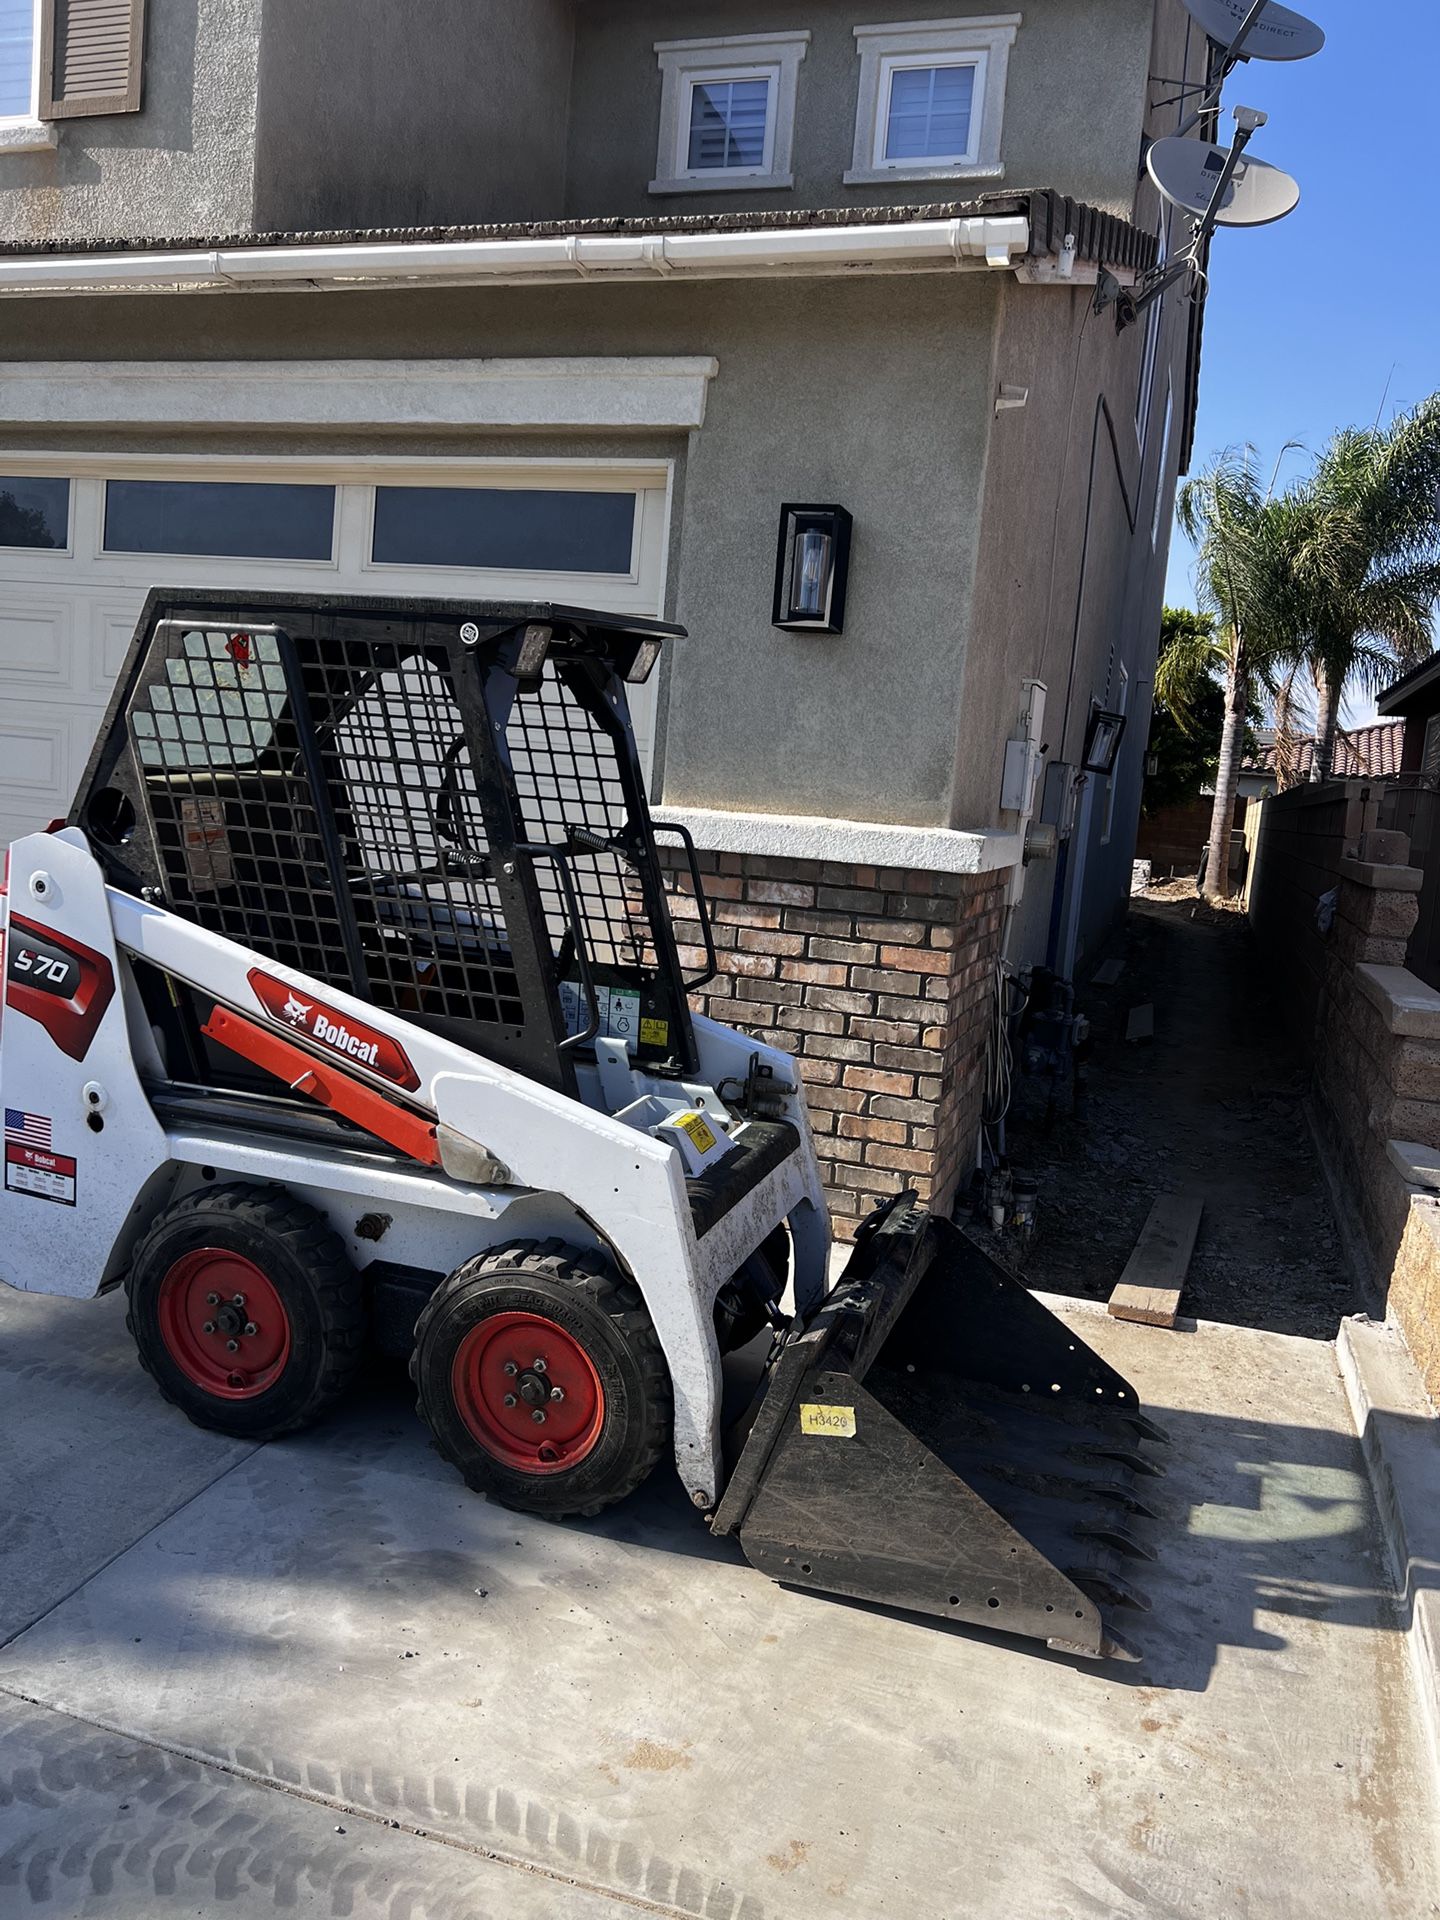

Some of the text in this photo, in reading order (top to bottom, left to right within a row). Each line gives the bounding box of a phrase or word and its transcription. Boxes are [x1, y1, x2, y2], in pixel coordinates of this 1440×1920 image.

[14, 949, 70, 983] S70
[312, 1013, 379, 1066] Bobcat
[34, 1154, 56, 1167] Bobcat
